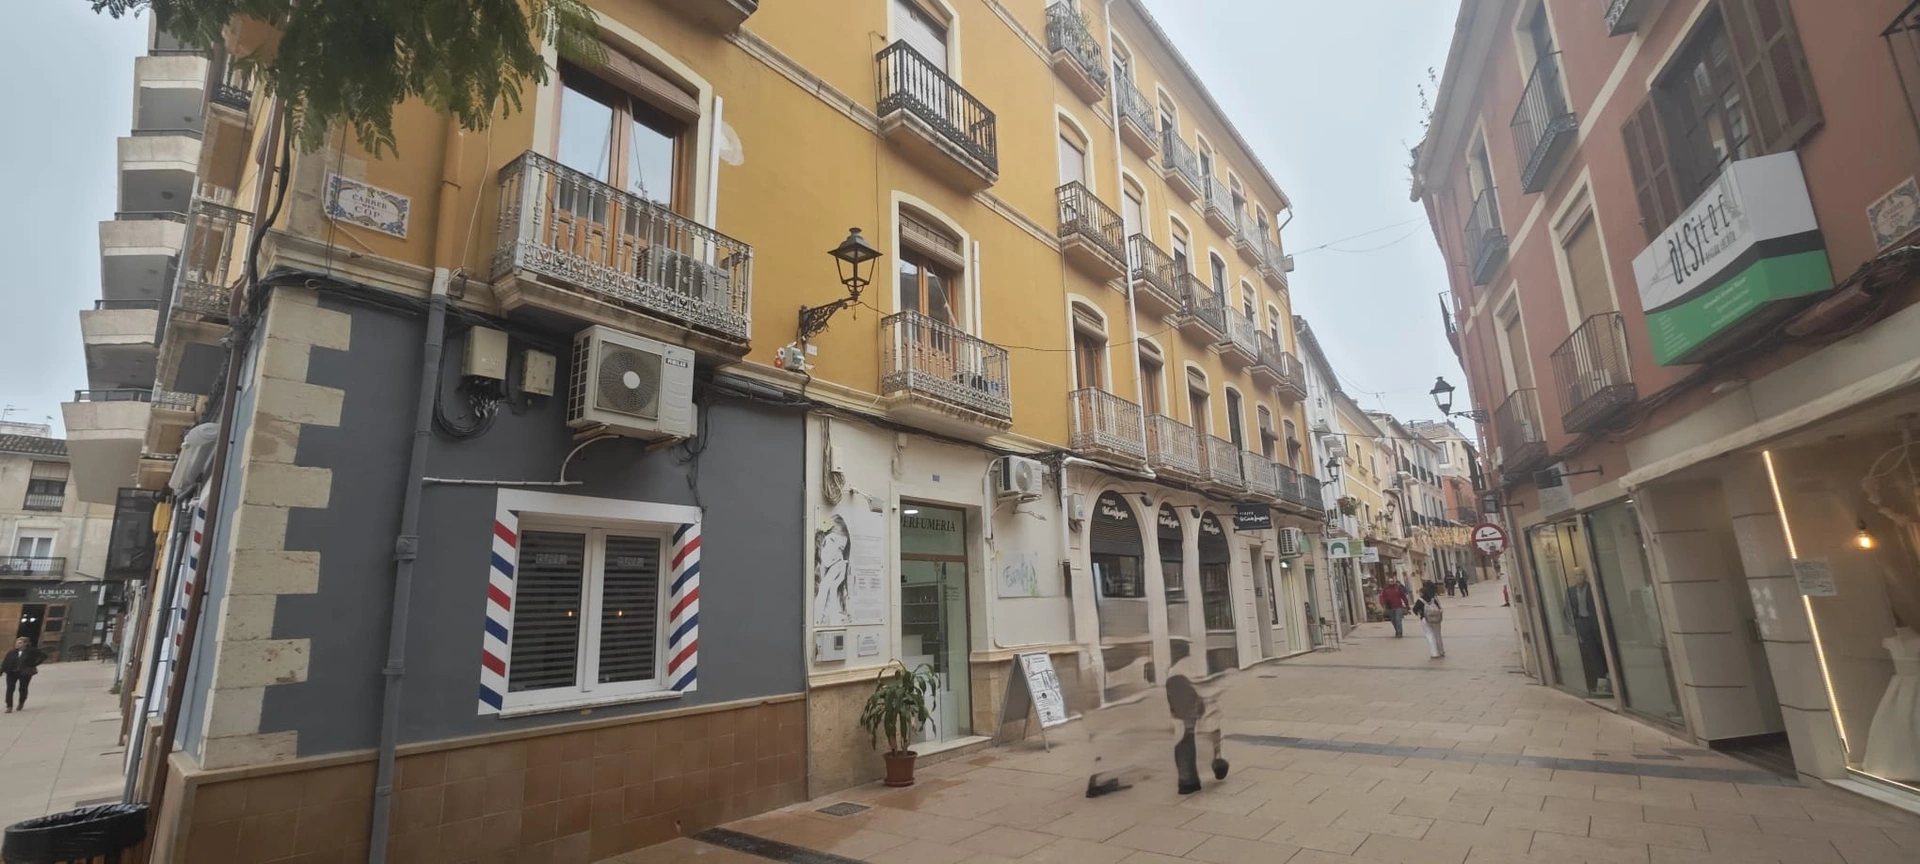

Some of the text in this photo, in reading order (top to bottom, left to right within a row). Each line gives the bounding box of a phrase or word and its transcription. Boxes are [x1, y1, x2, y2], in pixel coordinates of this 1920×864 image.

[352, 194, 387, 210] CARRER
[354, 206, 380, 218] COP
[901, 515, 956, 532] ERFUMERIA
